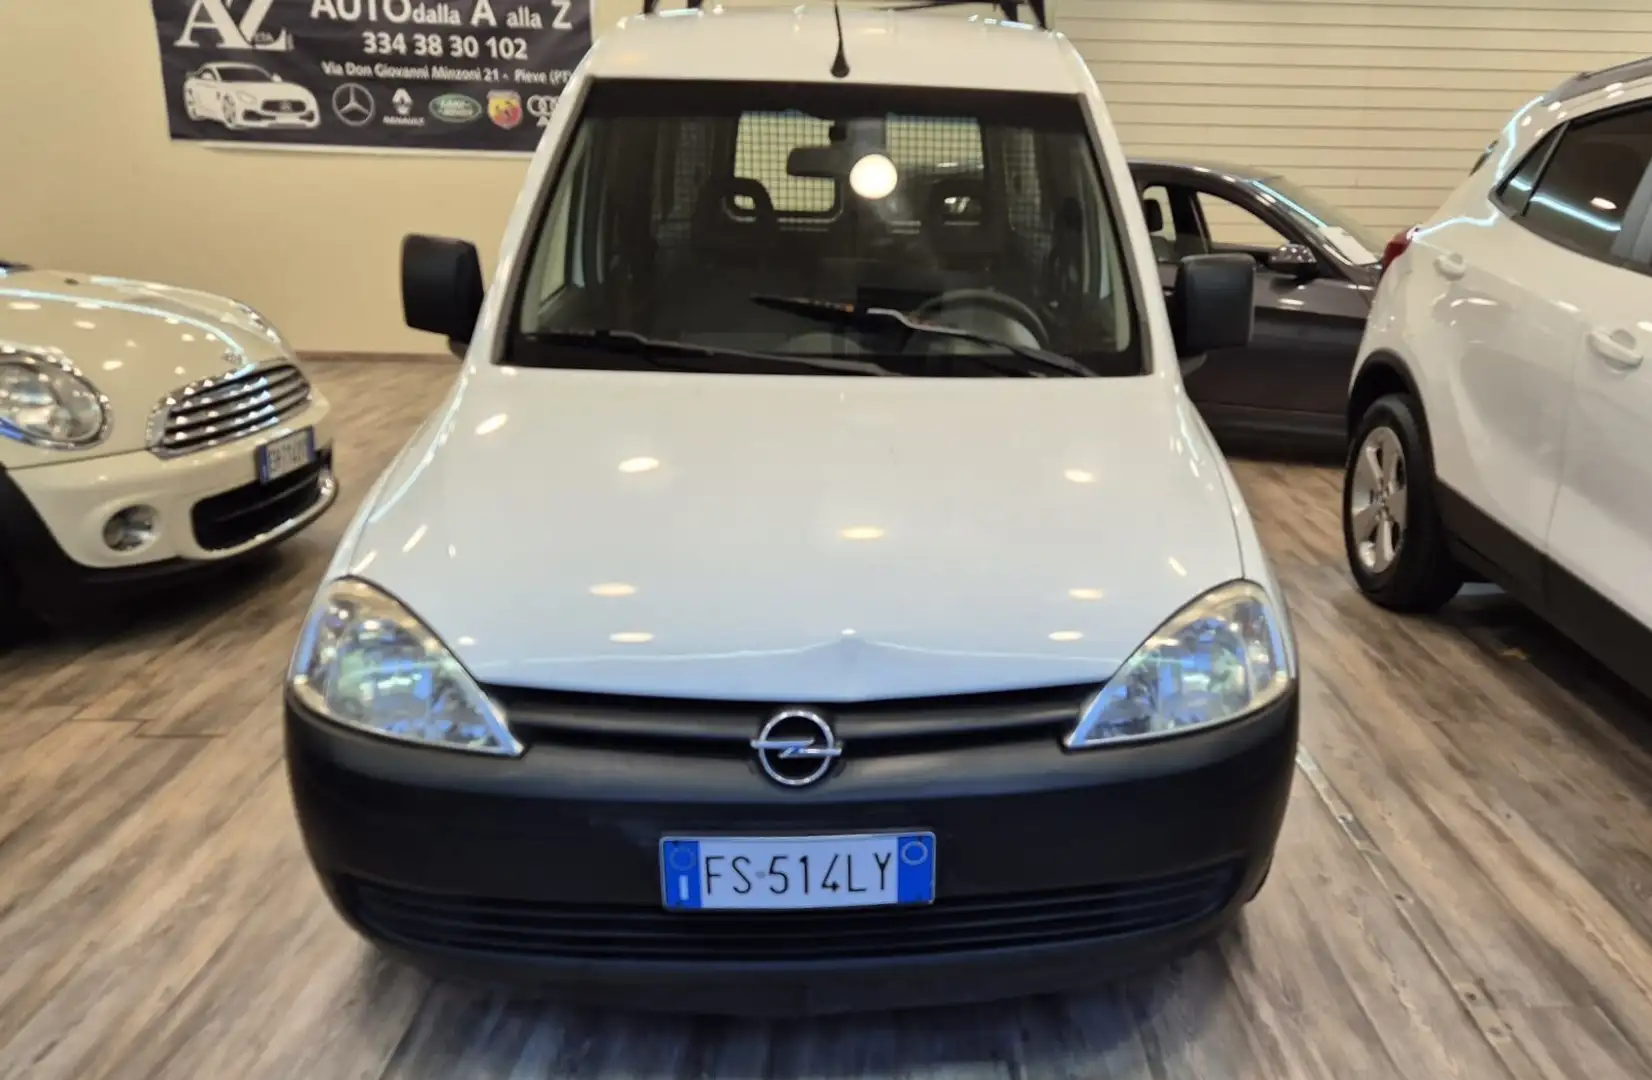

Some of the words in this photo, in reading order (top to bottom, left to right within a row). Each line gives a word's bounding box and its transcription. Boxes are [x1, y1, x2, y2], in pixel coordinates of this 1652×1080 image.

[470, 0, 497, 27] A
[506, 5, 543, 29] alla
[551, 0, 572, 30] Z
[362, 31, 407, 55] 334
[413, 33, 444, 57] 38
[449, 35, 479, 58] 30
[485, 36, 528, 60] 102
[321, 60, 345, 76] Via
[345, 61, 373, 77] Don
[374, 62, 429, 79] Giovanni
[431, 64, 482, 81] Minzoni
[484, 67, 499, 82] 21
[514, 68, 547, 84] Pieve
